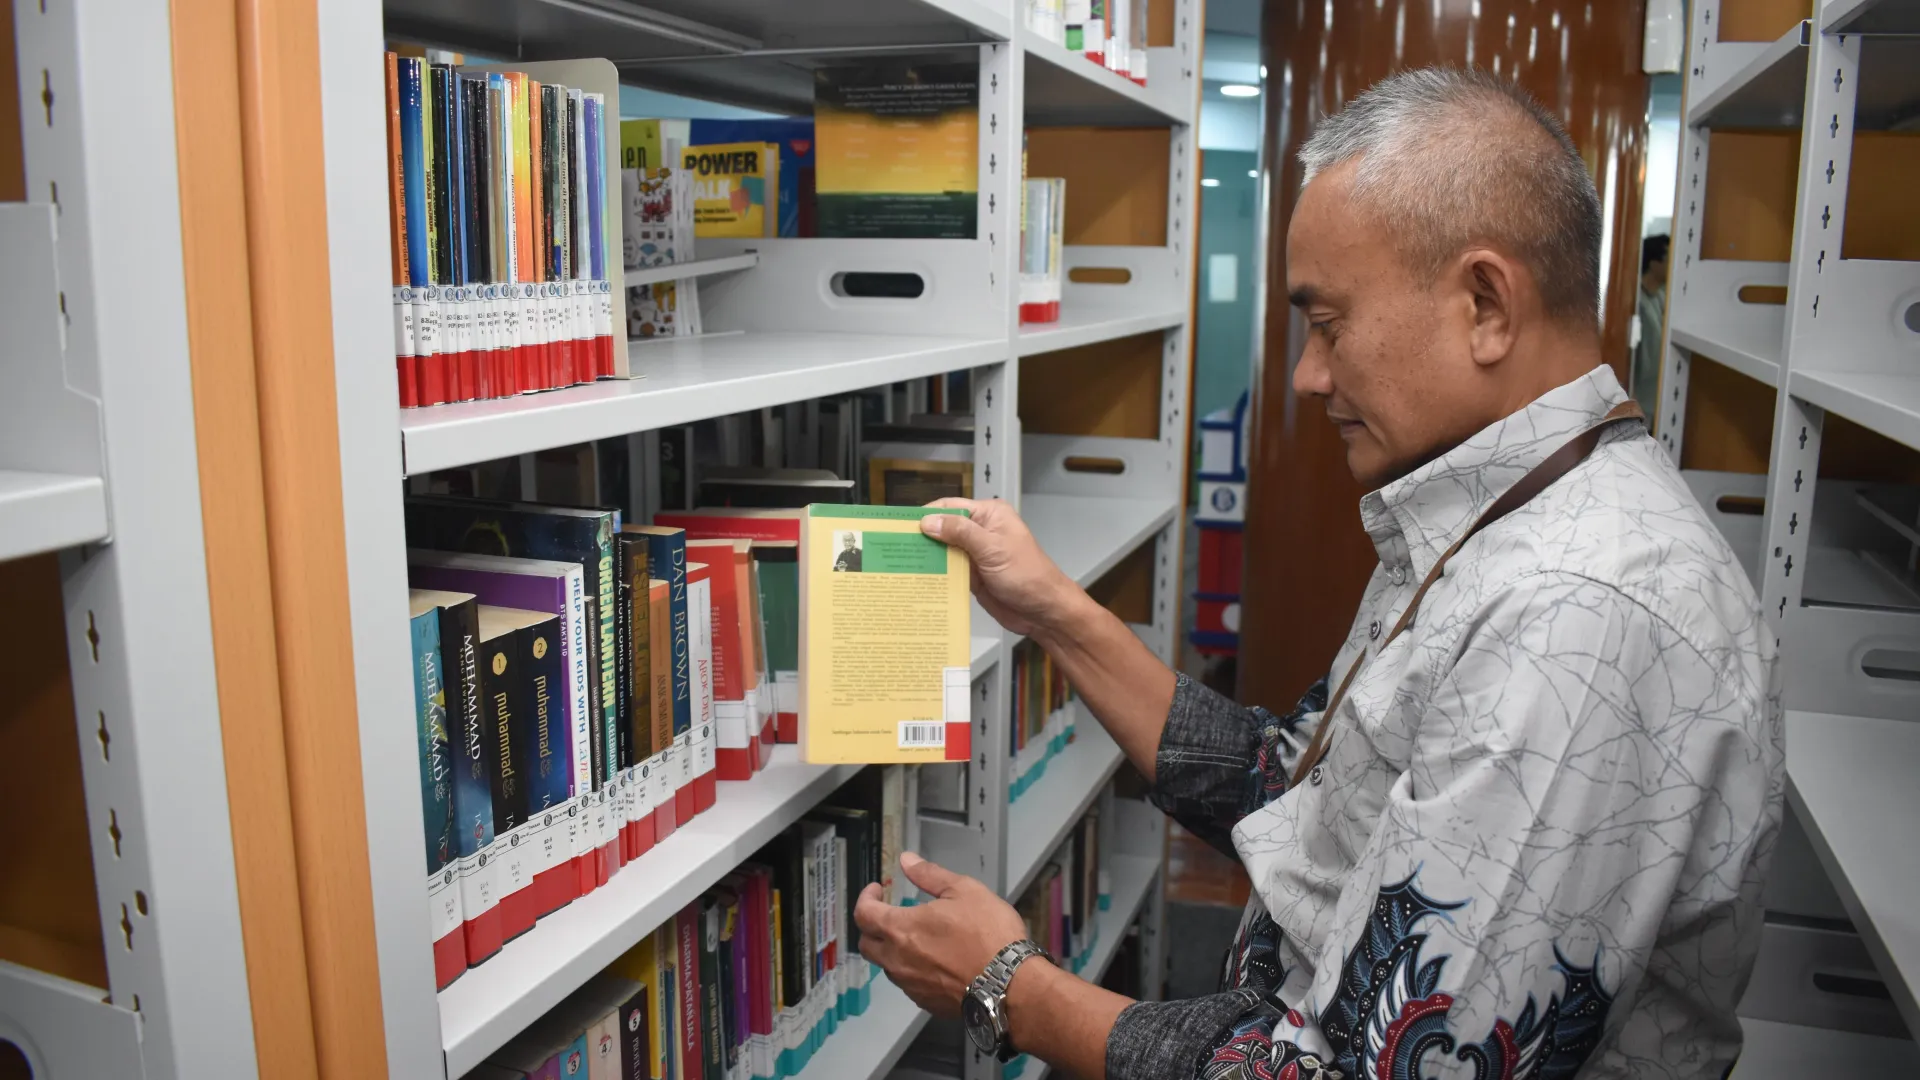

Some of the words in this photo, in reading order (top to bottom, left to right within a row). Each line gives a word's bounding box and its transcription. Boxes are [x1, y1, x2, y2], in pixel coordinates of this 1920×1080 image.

[685, 150, 758, 176] POWER
[402, 233, 410, 269] Merdeka
[573, 577, 581, 612] HELP
[599, 555, 614, 618] GREEN
[672, 549, 684, 602] DAN
[562, 648, 567, 657] ID
[574, 616, 583, 656] YOUR
[576, 660, 585, 692] KIDS
[600, 620, 616, 708] LANTERN
[674, 613, 688, 701] BROWN
[698, 659, 709, 693] AROK
[461, 679, 469, 720] PEWARIS
[464, 635, 481, 759] MUHAMMAD
[657, 674, 666, 697] ANAK
[425, 652, 443, 781] MUHAMMAD
[534, 675, 552, 758] muhammad
[577, 696, 586, 733] WITH
[494, 692, 514, 778] muhammad
[682, 925, 692, 979] DHARMA
[571, 1060, 577, 1071] 3
[602, 1042, 608, 1054] 4
